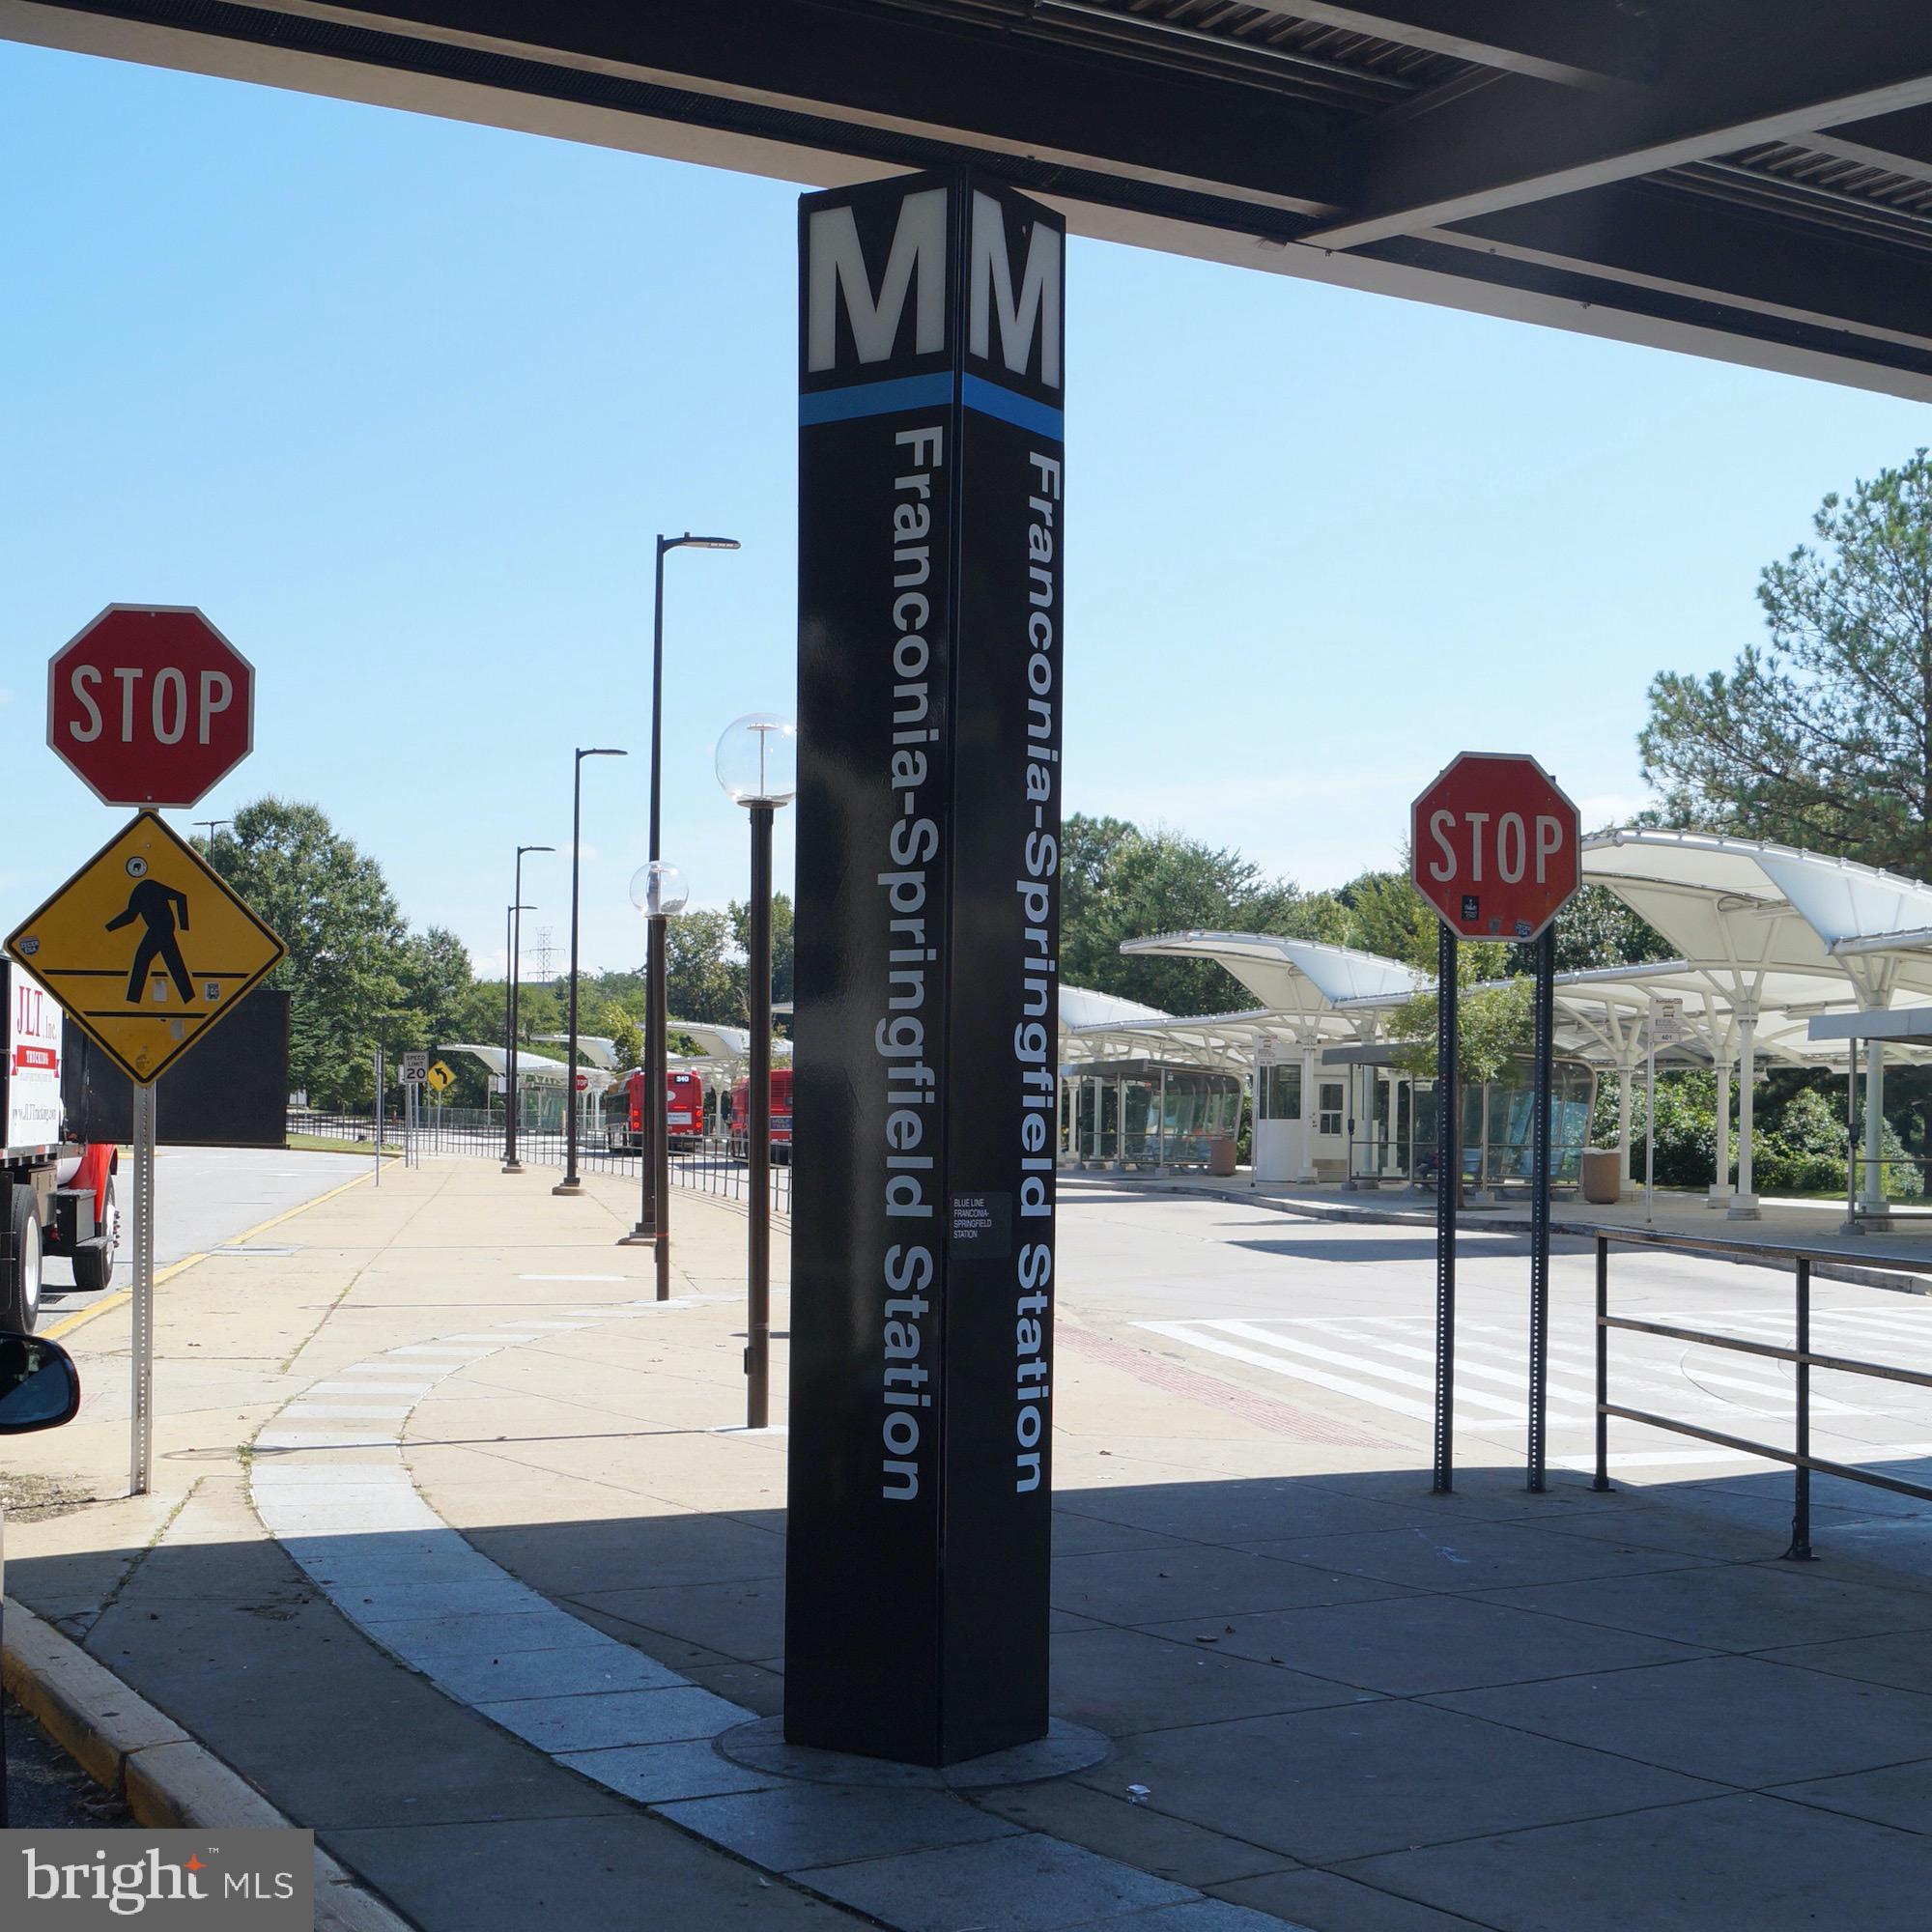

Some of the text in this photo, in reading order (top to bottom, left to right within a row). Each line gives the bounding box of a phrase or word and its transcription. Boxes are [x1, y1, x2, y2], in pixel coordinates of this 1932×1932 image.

[808, 187, 947, 373] M
[969, 189, 1061, 389] M
[70, 664, 233, 745] STOP
[1429, 810, 1563, 884] STOP
[874, 425, 943, 1501] Franconia-Springfield Station
[1013, 450, 1061, 1493] Franconia-Springfield Station
[407, 1067, 425, 1079] 20
[953, 1198, 985, 1208] BLUE LINE
[953, 1208, 990, 1218] FRANCONIA-
[953, 1219, 992, 1229] SPRINGFIELD
[953, 1230, 978, 1238] STATION
